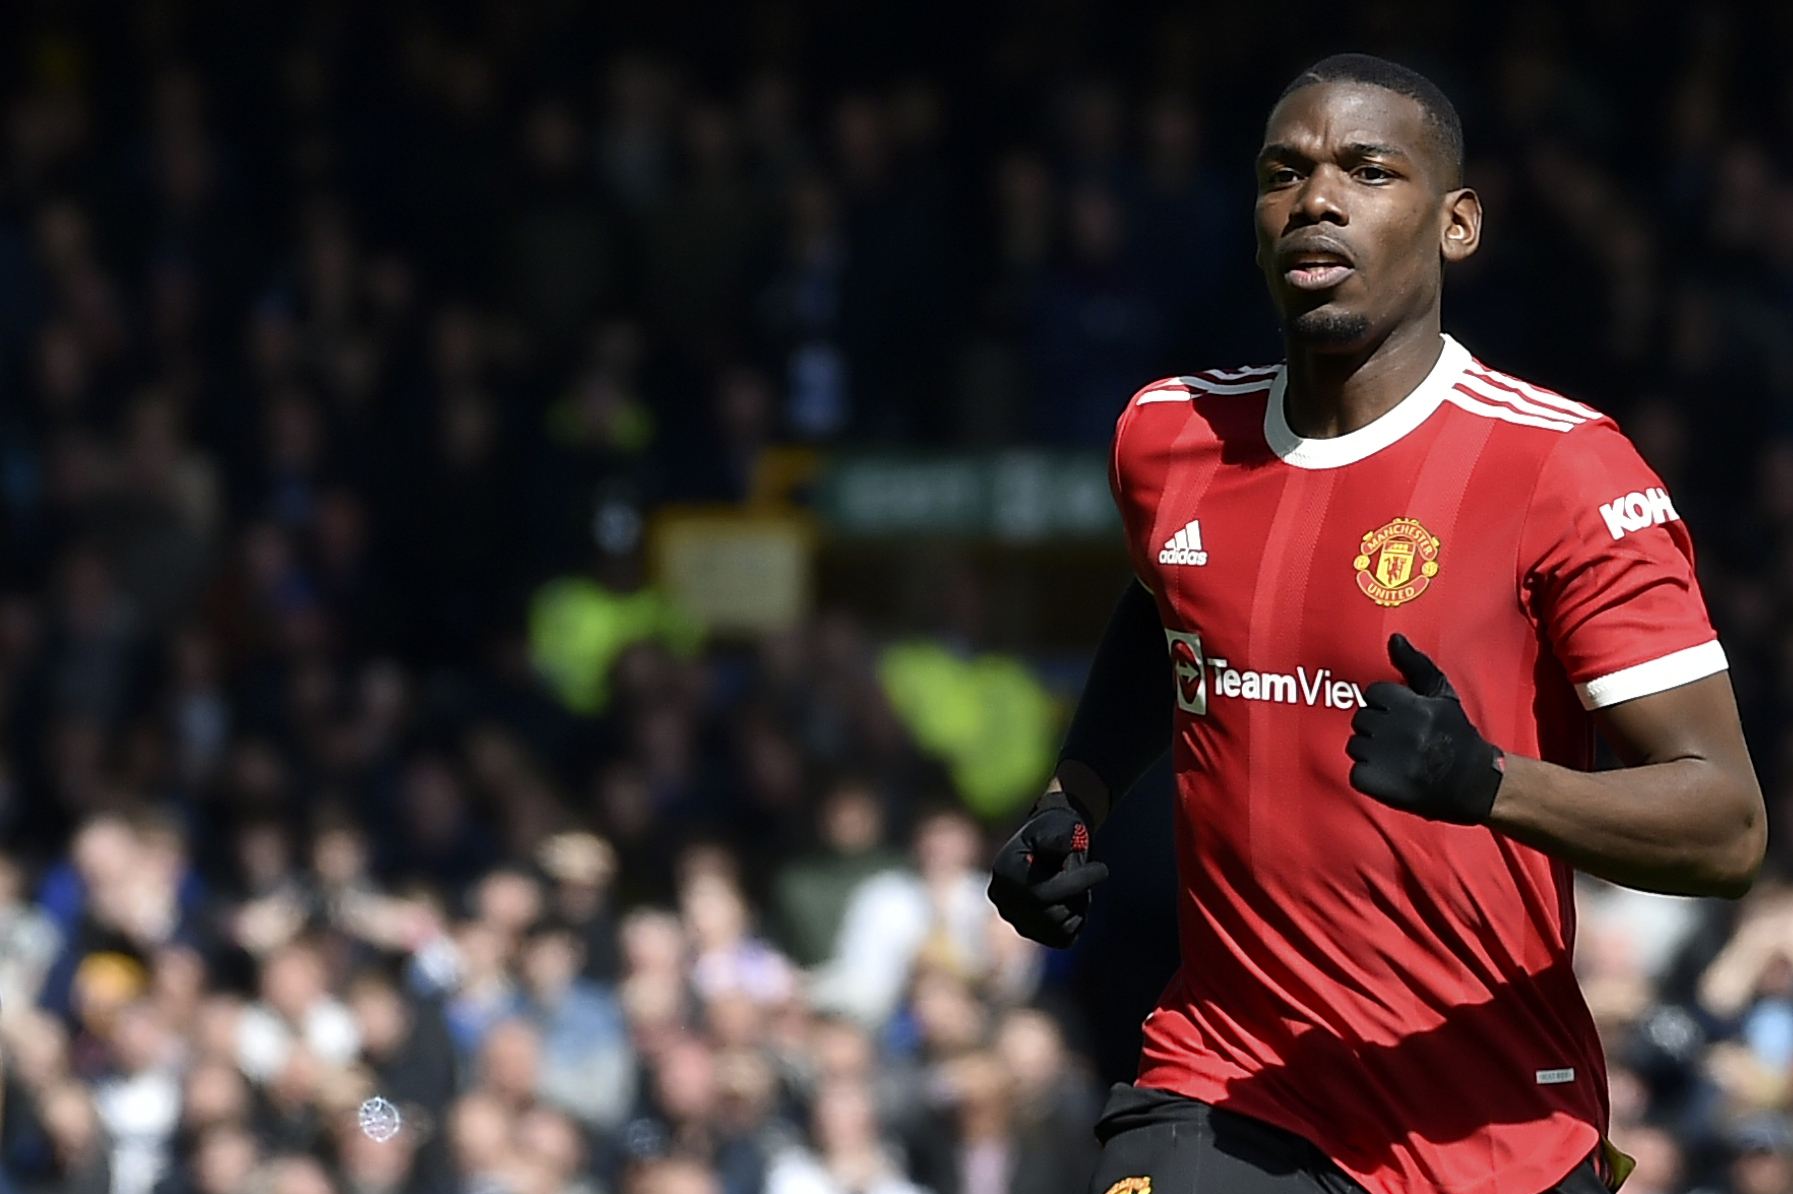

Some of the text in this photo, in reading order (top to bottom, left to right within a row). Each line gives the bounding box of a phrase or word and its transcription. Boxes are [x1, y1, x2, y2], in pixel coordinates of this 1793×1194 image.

[1367, 525, 1433, 556] MANCHESTER
[1159, 546, 1208, 566] adidas
[1367, 583, 1415, 600] UNITED
